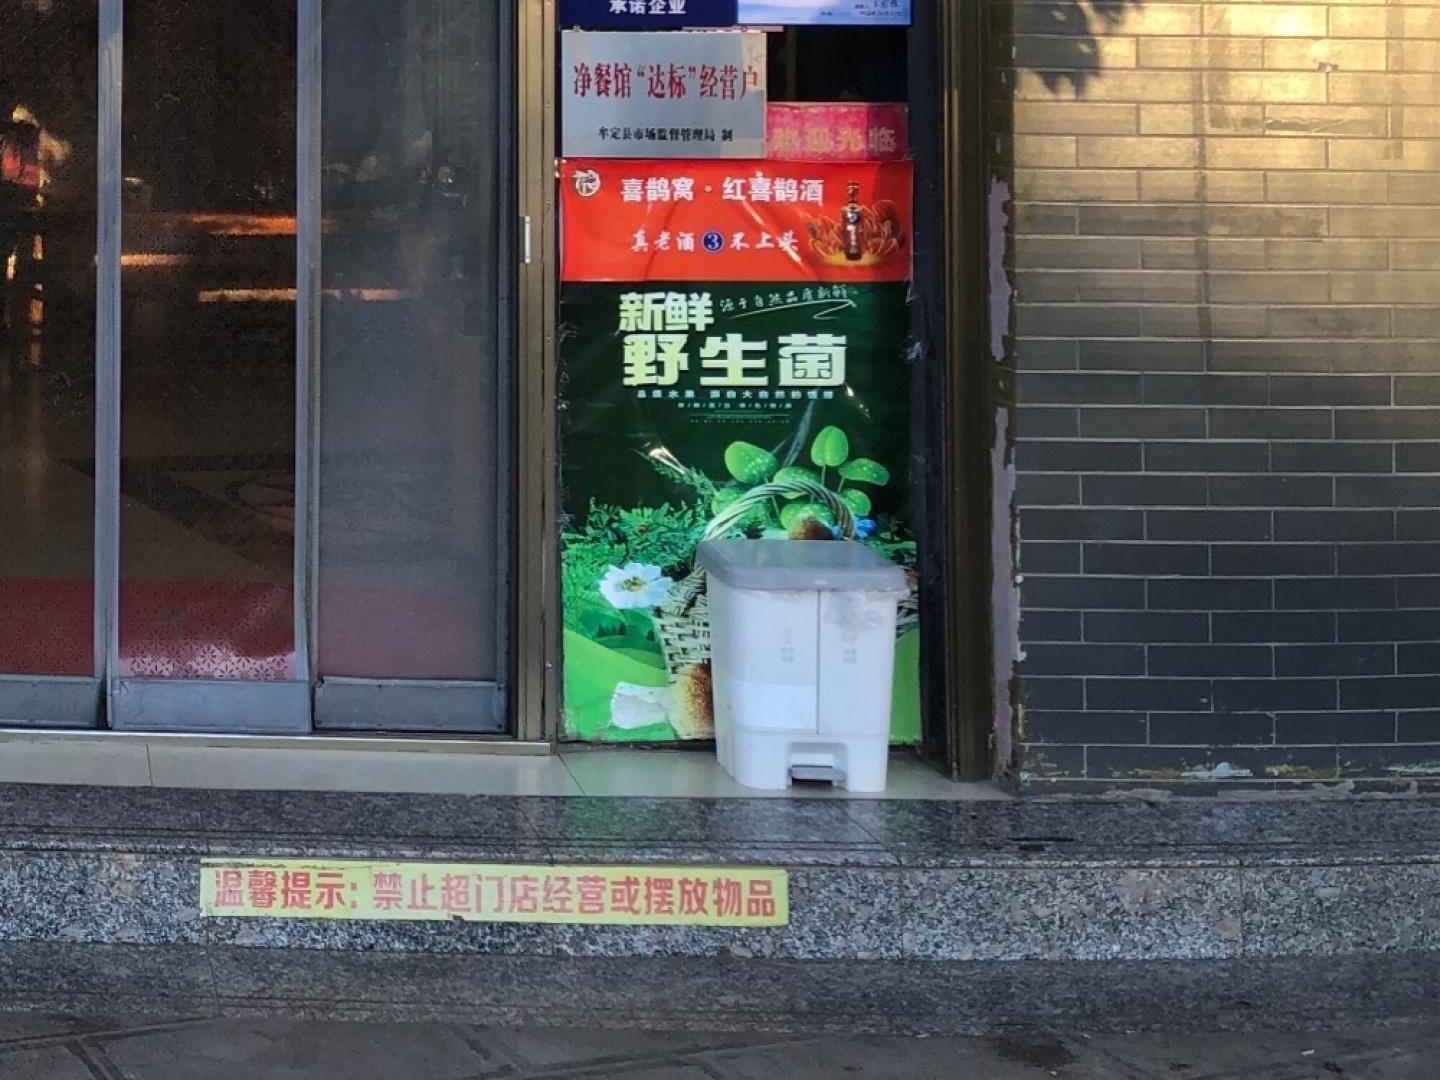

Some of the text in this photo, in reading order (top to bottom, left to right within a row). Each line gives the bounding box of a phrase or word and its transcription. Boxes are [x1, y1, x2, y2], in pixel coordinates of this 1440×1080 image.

[572, 61, 759, 101] 净餐馆“达标”经营户
[598, 126, 734, 142] 牟定县市场监督管理局 制
[618, 290, 715, 332] 新鲜
[622, 332, 848, 387] 野生菌
